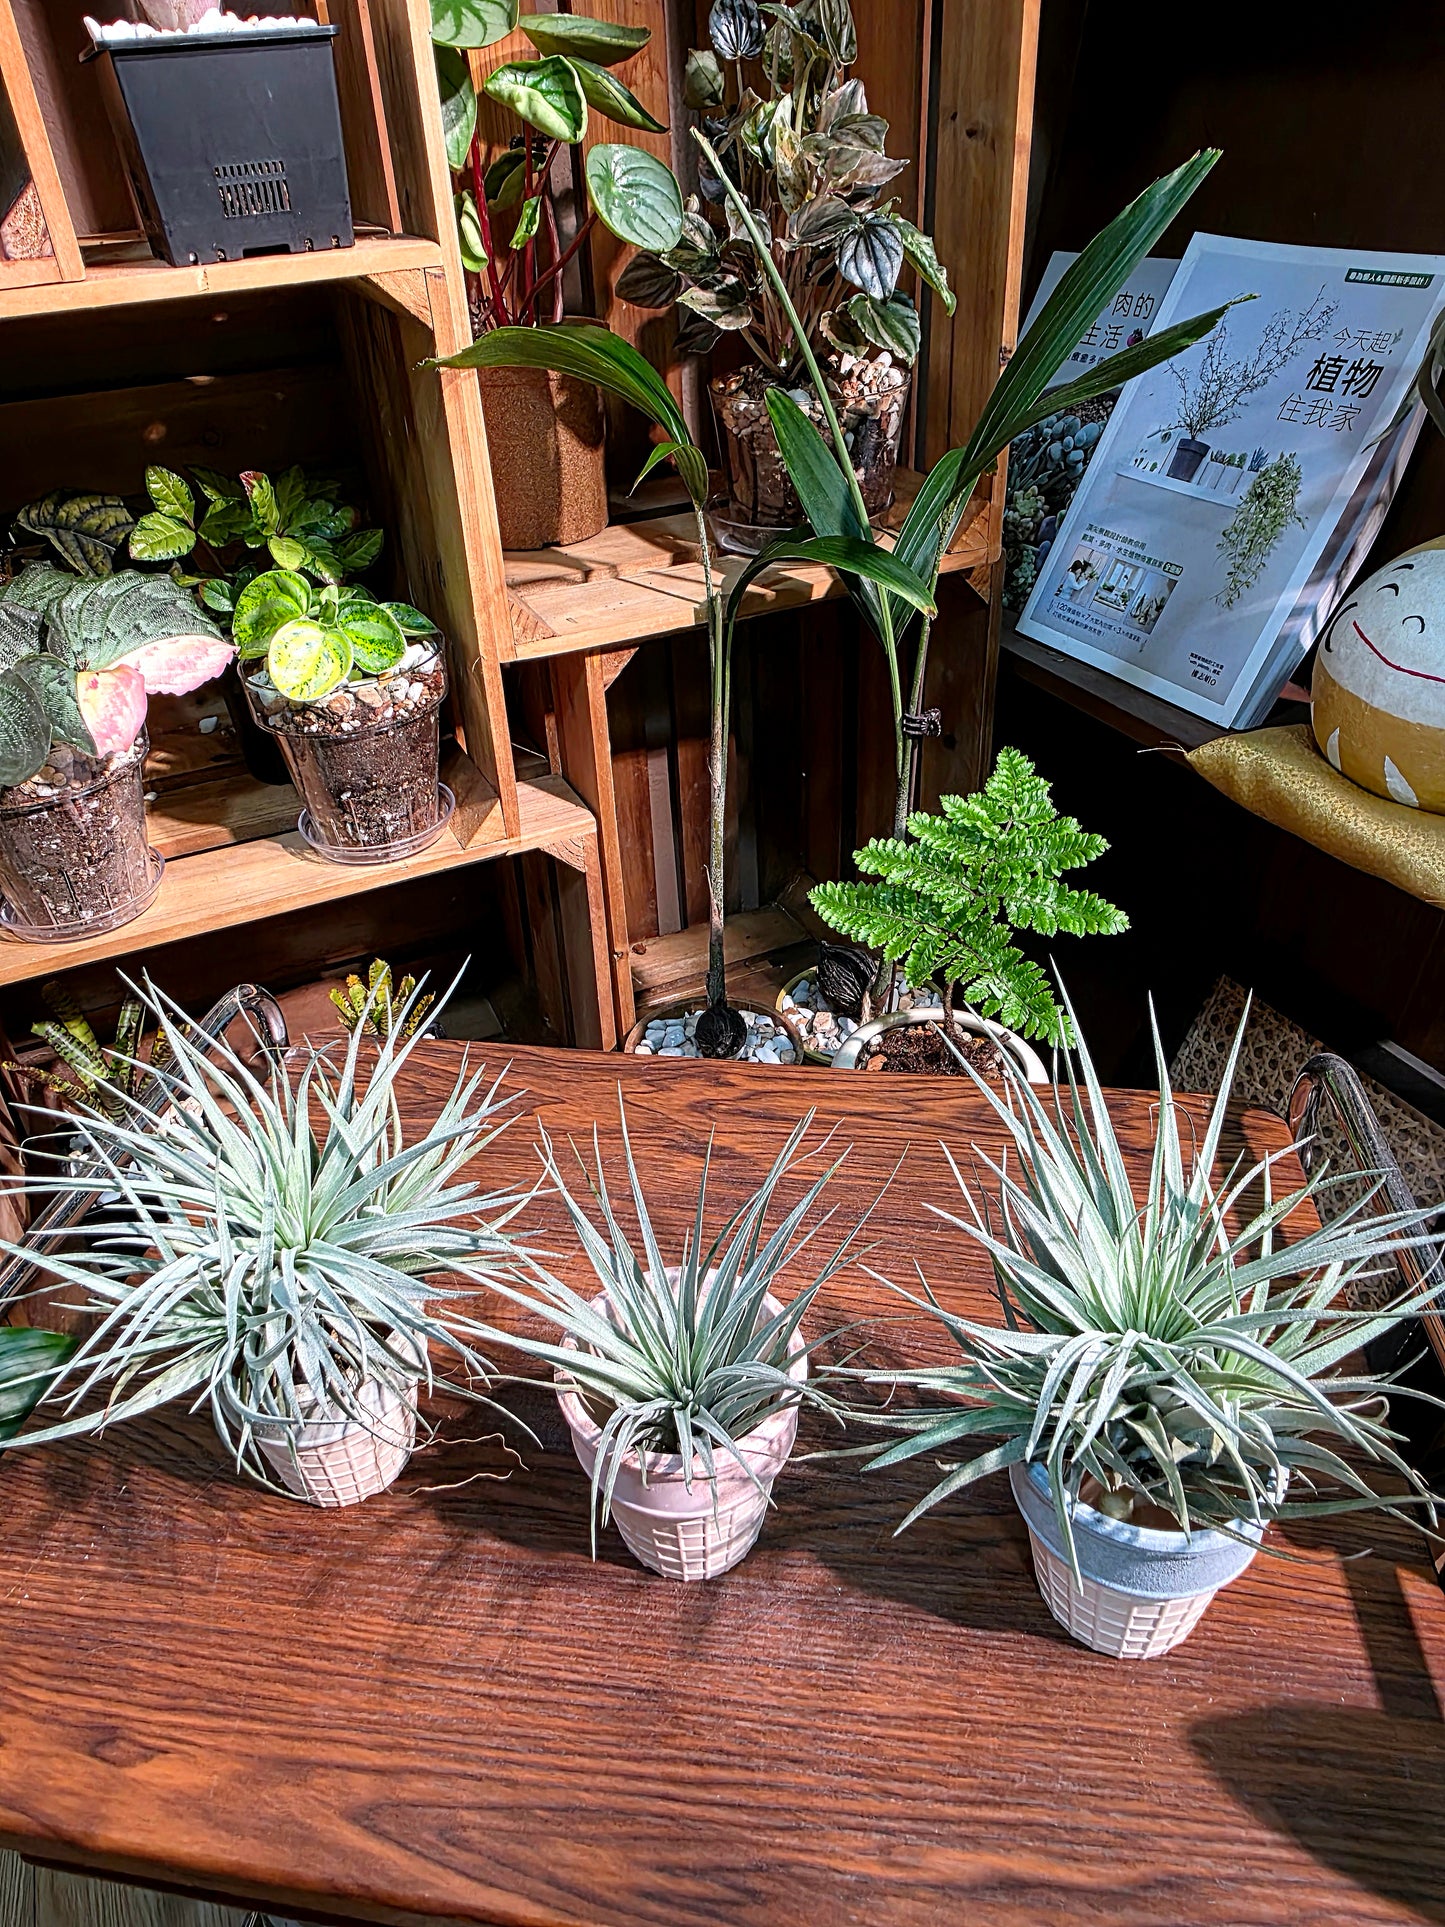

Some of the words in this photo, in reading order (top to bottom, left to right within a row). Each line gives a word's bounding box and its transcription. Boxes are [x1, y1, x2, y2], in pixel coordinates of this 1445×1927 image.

[1107, 291, 1155, 320] 肉的
[1079, 321, 1125, 350] 生活
[1305, 352, 1385, 399] 植物
[1276, 392, 1362, 432] 住我家
